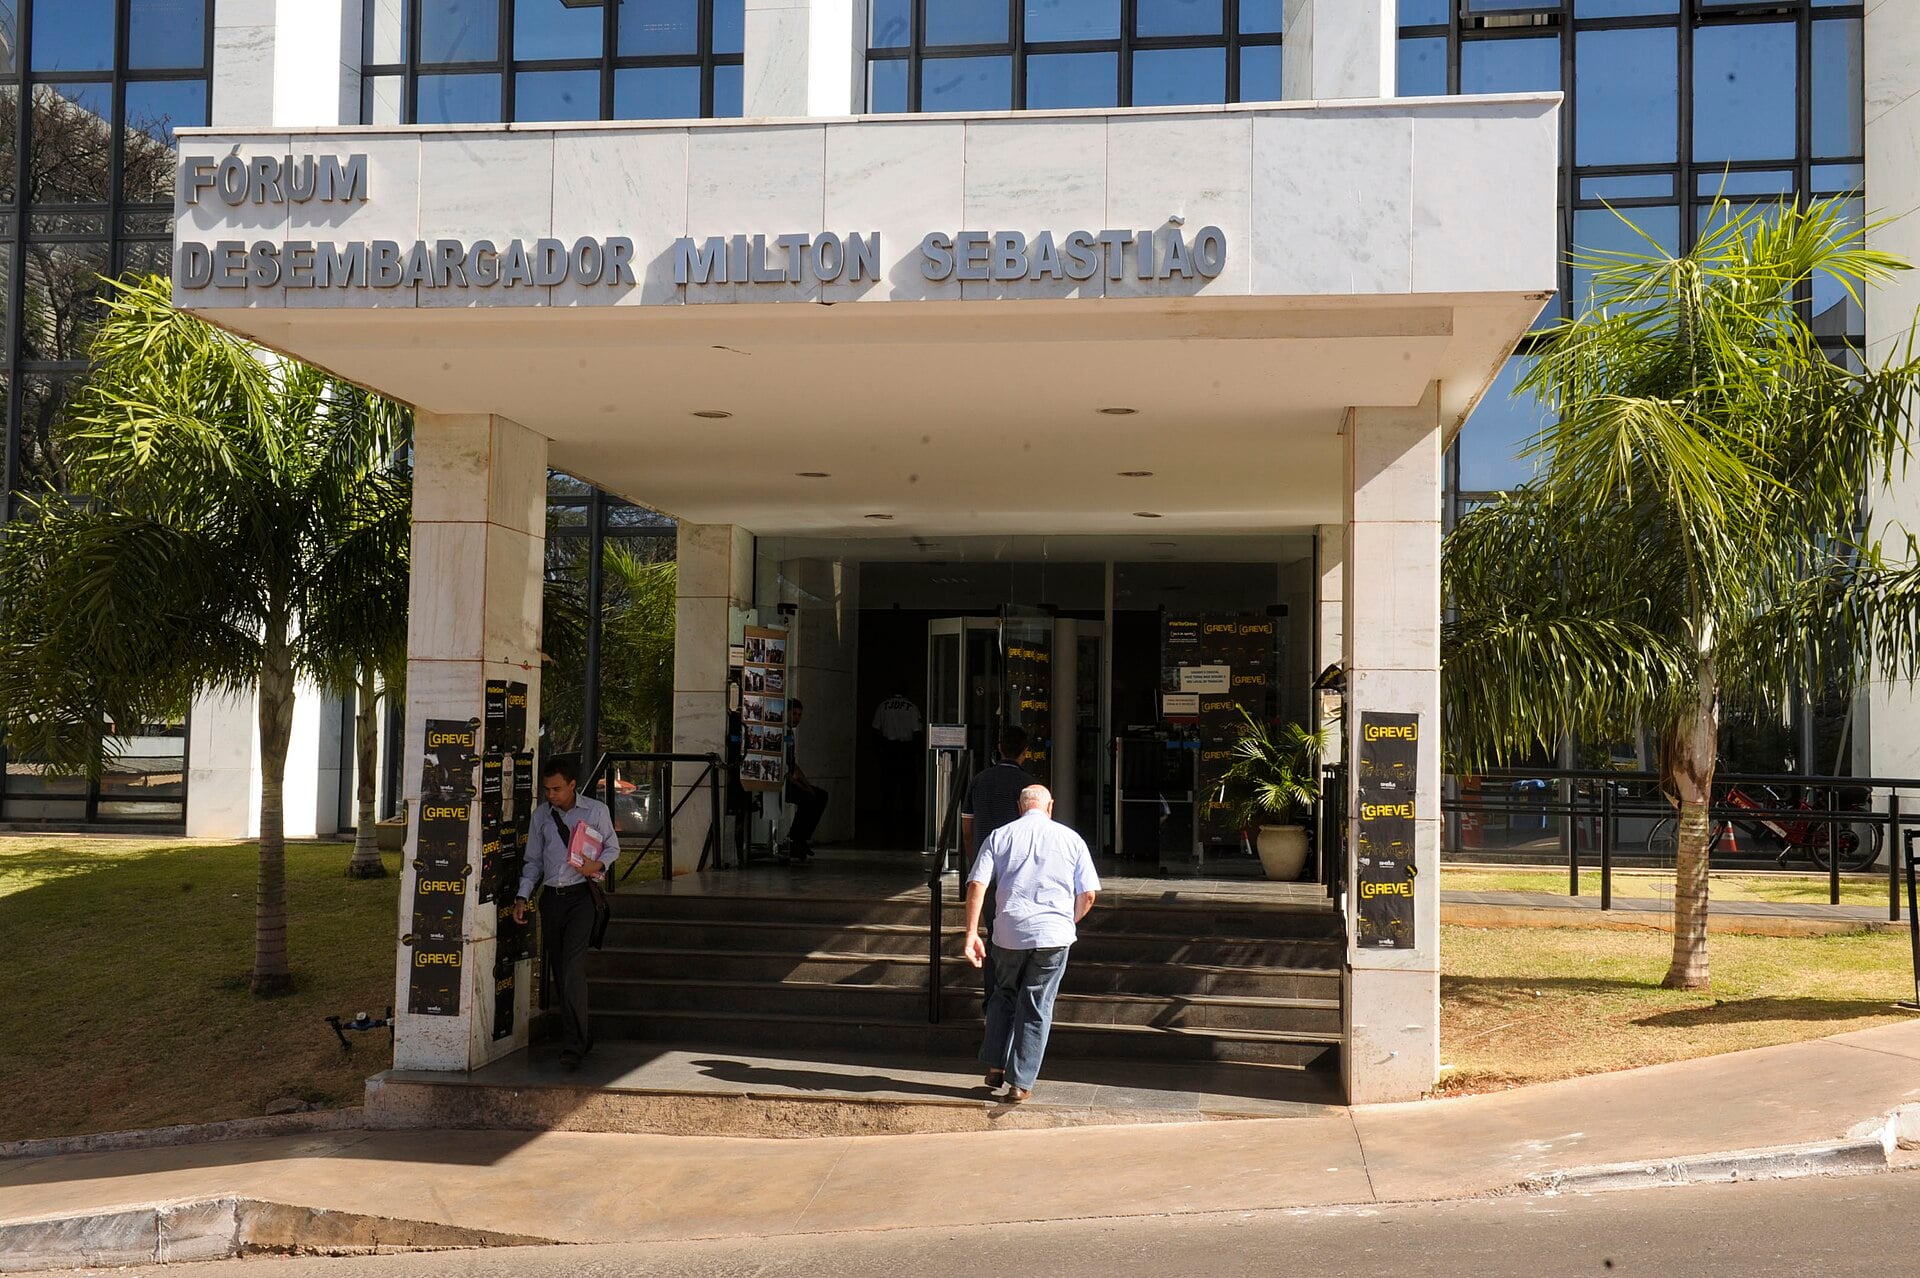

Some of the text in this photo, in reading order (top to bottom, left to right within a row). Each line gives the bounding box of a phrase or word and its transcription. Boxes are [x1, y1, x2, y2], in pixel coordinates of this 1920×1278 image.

[184, 145, 369, 206] FÓRUM
[180, 213, 1229, 291] DESEMBARGADOR MILTON SEBASTIÃO
